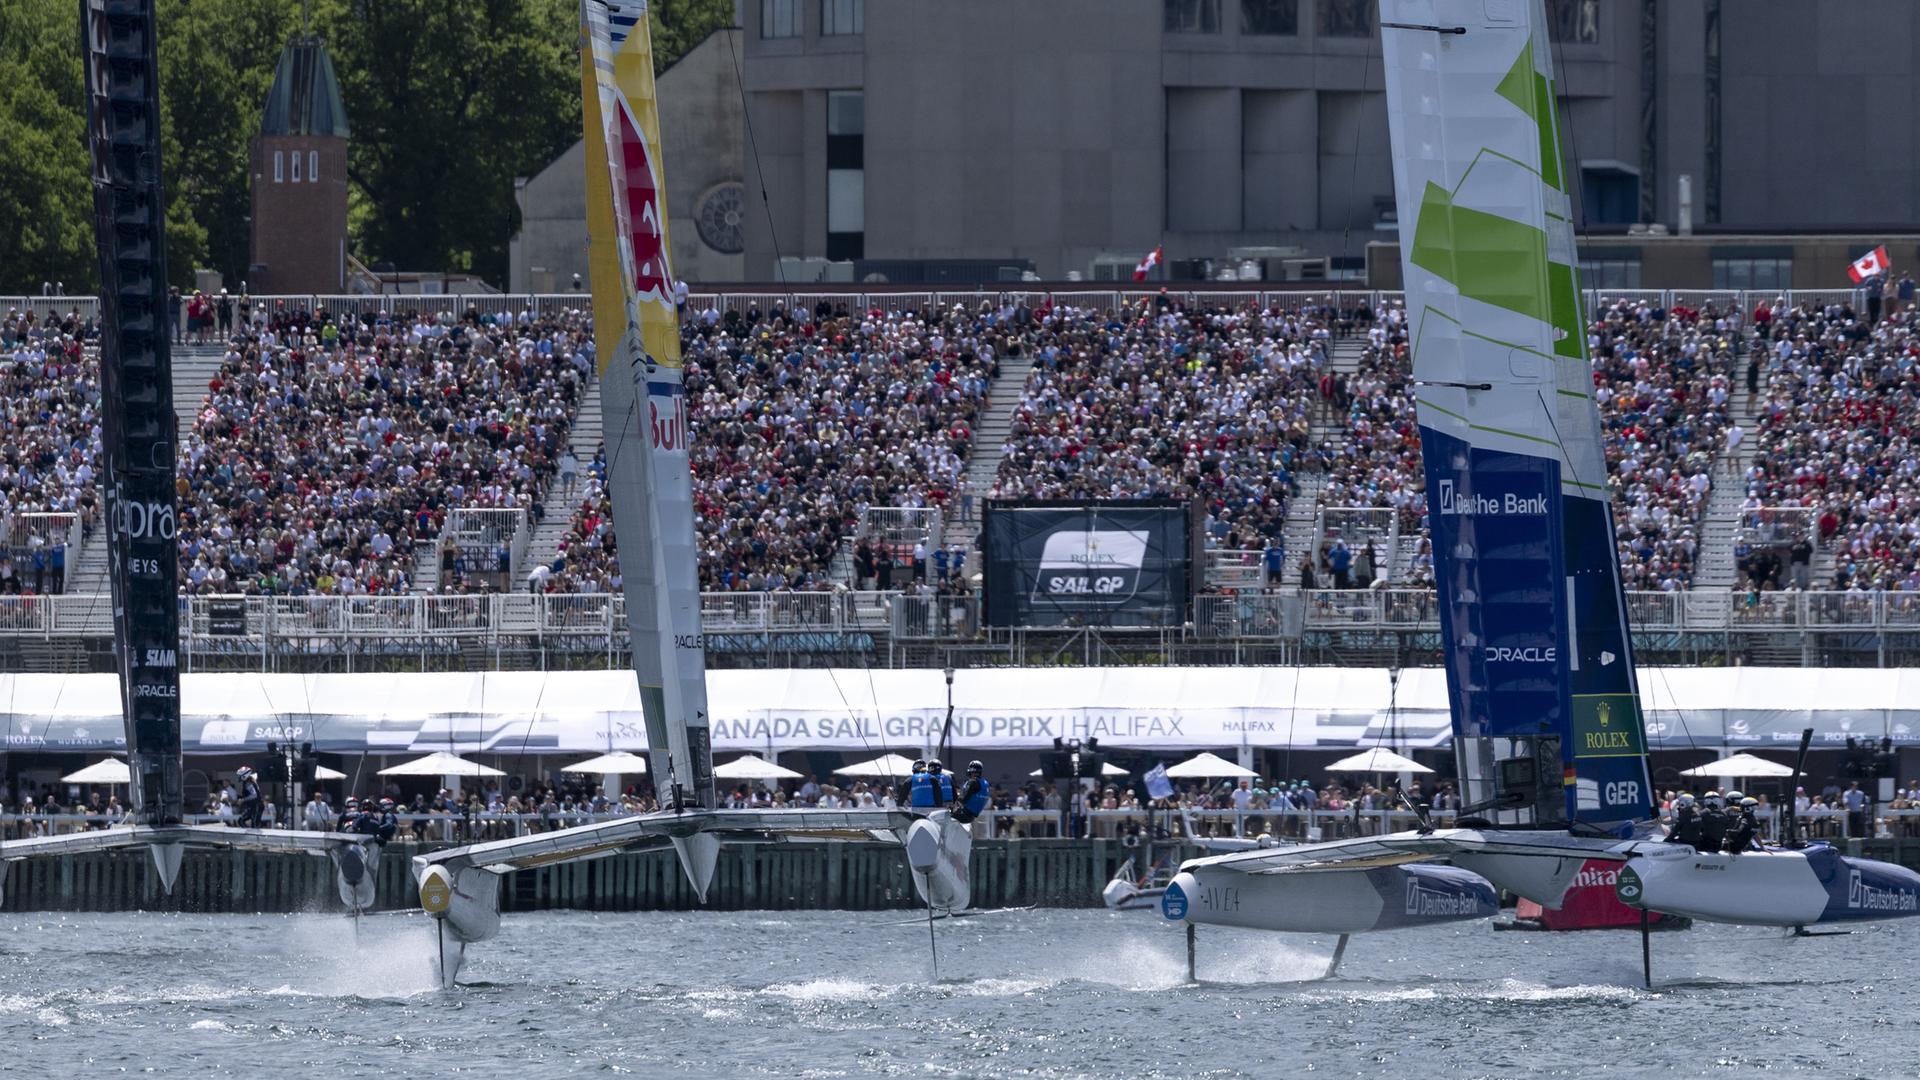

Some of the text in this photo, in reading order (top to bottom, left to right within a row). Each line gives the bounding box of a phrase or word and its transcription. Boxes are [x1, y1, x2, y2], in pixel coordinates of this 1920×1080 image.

[649, 397, 686, 451] Bull
[1504, 492, 1547, 514] Bank
[711, 715, 1184, 739] ANADA SAIL GRAND PRIX HALIFAX
[1222, 721, 1276, 732] HALIFAX
[5, 735, 47, 745] ROLEX
[1585, 732, 1629, 749] ROLEX
[1605, 781, 1639, 805] GER
[1421, 892, 1479, 915] Deutsche Bank
[1862, 887, 1917, 910] Deutsche Bank
